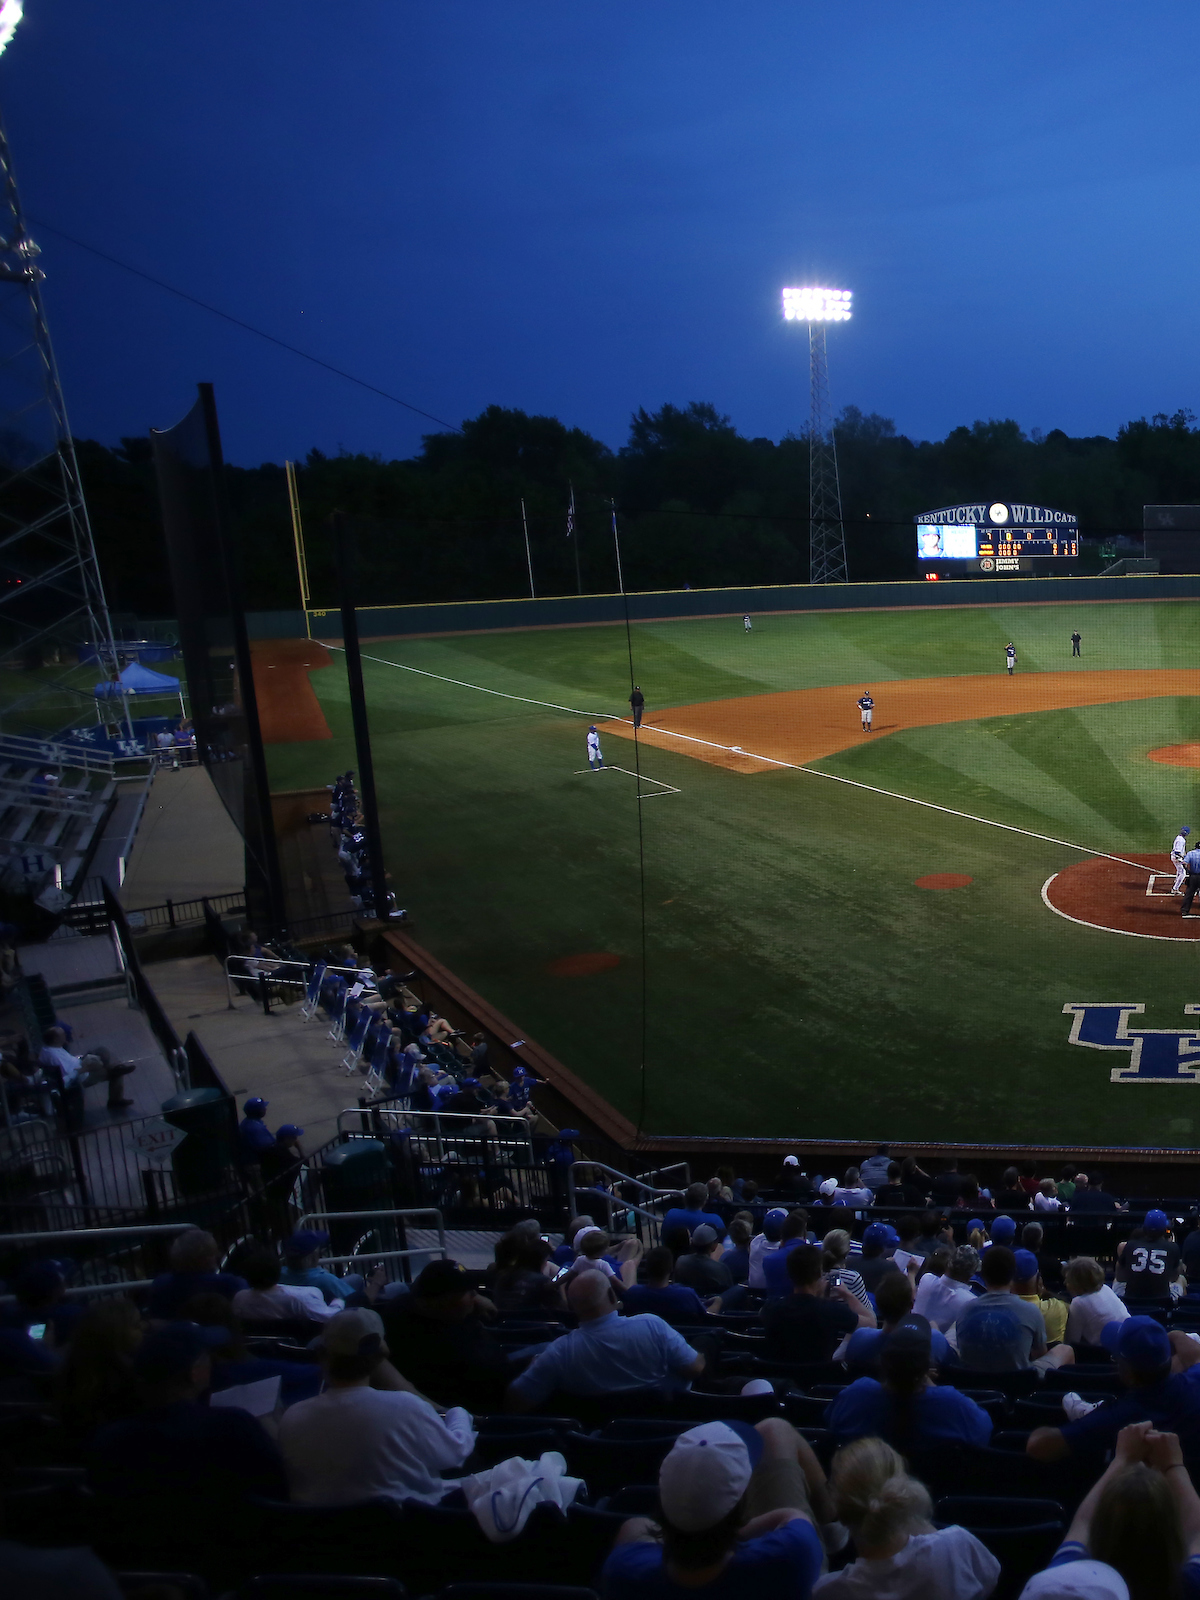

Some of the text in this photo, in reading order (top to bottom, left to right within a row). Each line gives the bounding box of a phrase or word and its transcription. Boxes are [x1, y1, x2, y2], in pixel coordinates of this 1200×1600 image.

[918, 504, 1077, 523] KENTUCKY WILDCATS
[116, 739, 147, 757] UK
[20, 854, 46, 874] H
[137, 1130, 176, 1148] EXIT
[1131, 1247, 1168, 1275] 35
